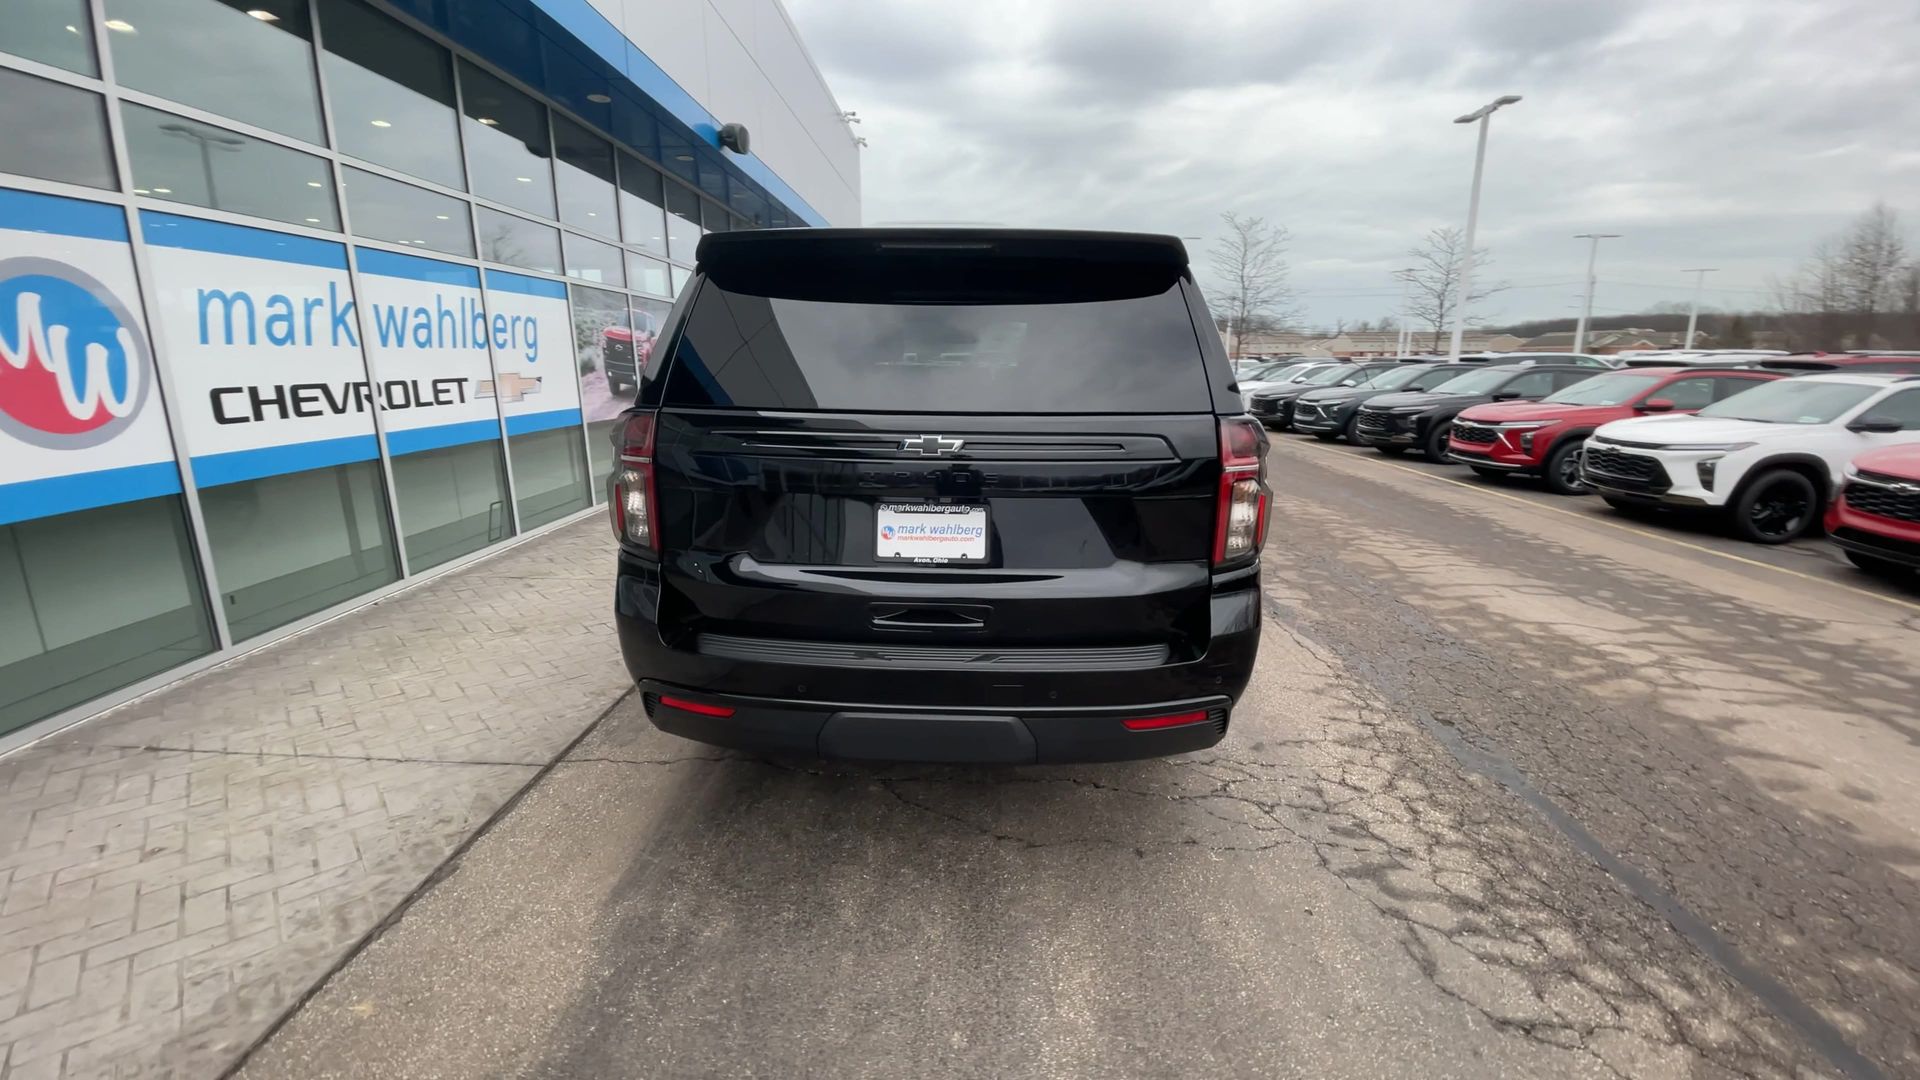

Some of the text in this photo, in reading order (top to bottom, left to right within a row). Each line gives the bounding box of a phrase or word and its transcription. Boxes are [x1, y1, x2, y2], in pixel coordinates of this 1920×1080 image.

[197, 281, 538, 363] mark wahlberg
[209, 377, 469, 425] CHEVROLET
[897, 523, 927, 534] mark
[930, 524, 983, 537] wahlberg
[897, 535, 975, 543] markwahlbergauto.com
